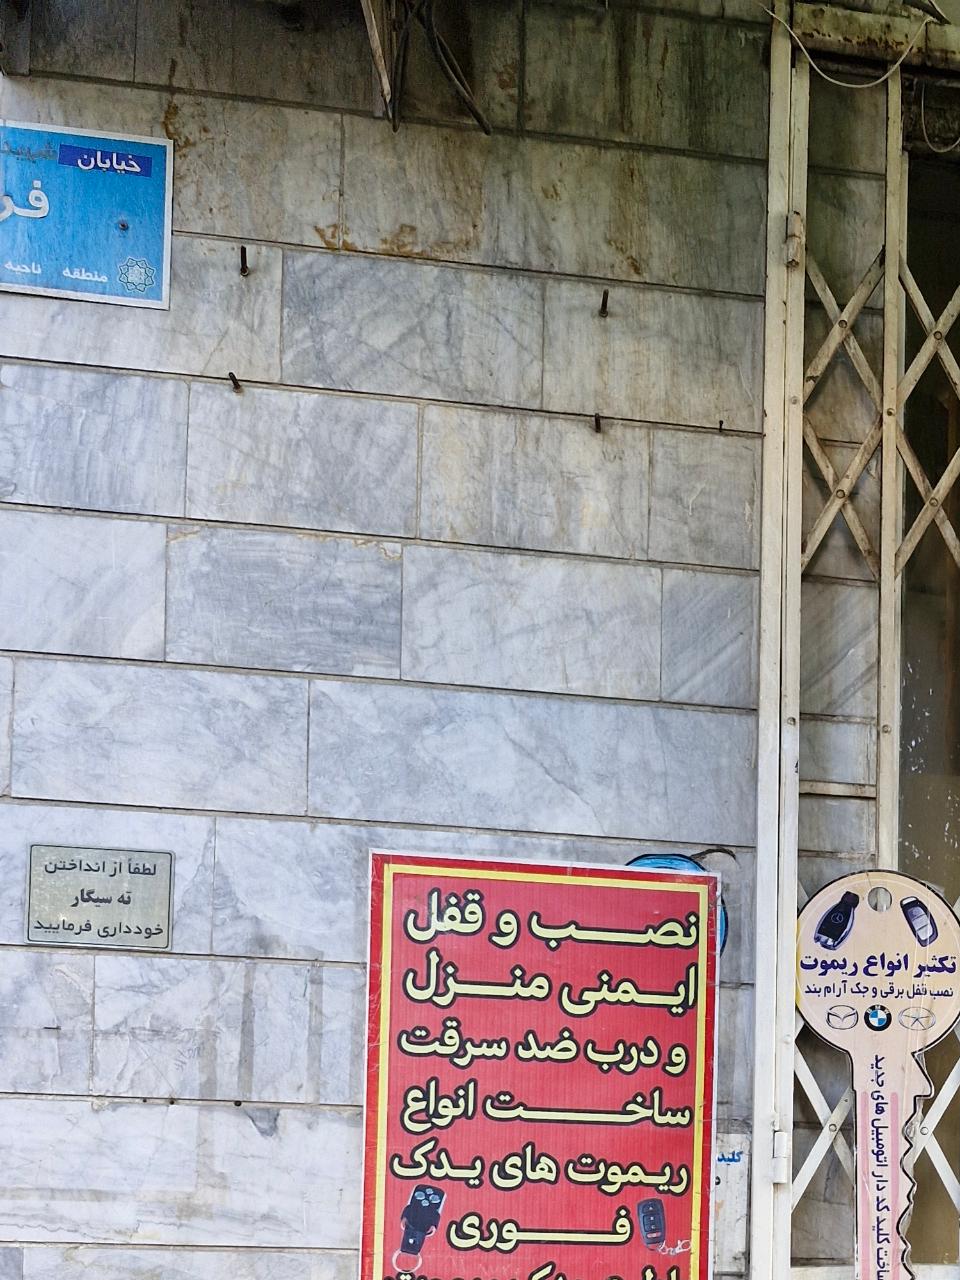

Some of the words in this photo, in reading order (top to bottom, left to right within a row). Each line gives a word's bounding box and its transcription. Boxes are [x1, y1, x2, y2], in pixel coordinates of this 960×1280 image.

[77, 150, 142, 174] خیابان
[4, 260, 42, 275] ناحیه
[62, 266, 109, 283] منطقه
[44, 859, 106, 874] انداختن
[108, 861, 122, 877] از
[70, 888, 113, 907] سیگار
[117, 891, 132, 905] ته
[33, 919, 92, 935] فرمایید
[404, 888, 485, 943] قفل
[97, 922, 164, 939] خودداری
[489, 910, 520, 949] و
[529, 911, 699, 950] نصب
[800, 955, 858, 976] ریموت
[862, 952, 909, 976] انواع
[913, 955, 957, 978] تکثیر
[404, 949, 552, 1007] منزل
[804, 983, 822, 997] بند
[823, 980, 848, 997] آرام
[850, 980, 869, 997] جک
[880, 982, 905, 998] برقی
[560, 965, 698, 1016] ایمنی
[871, 986, 877, 997] و
[906, 983, 927, 999] قفل
[929, 987, 954, 1000] نصب
[399, 1017, 509, 1068] سرقت
[517, 1028, 578, 1062] ضد
[585, 1037, 660, 1073] درب
[664, 1041, 688, 1075] و
[871, 1054, 885, 1088] جدید
[402, 1077, 478, 1133] انواع
[483, 1087, 692, 1126] ساخت
[871, 1090, 888, 1115] های
[871, 1118, 889, 1167] اتومبیل
[391, 1137, 484, 1188] یدک
[490, 1141, 558, 1190] های
[716, 1151, 743, 1165] کلید
[565, 1155, 690, 1196] ریموت
[872, 1171, 888, 1191] دار
[876, 1196, 890, 1212] کد
[449, 1205, 634, 1252] فوری
[872, 1216, 891, 1244] کلید
